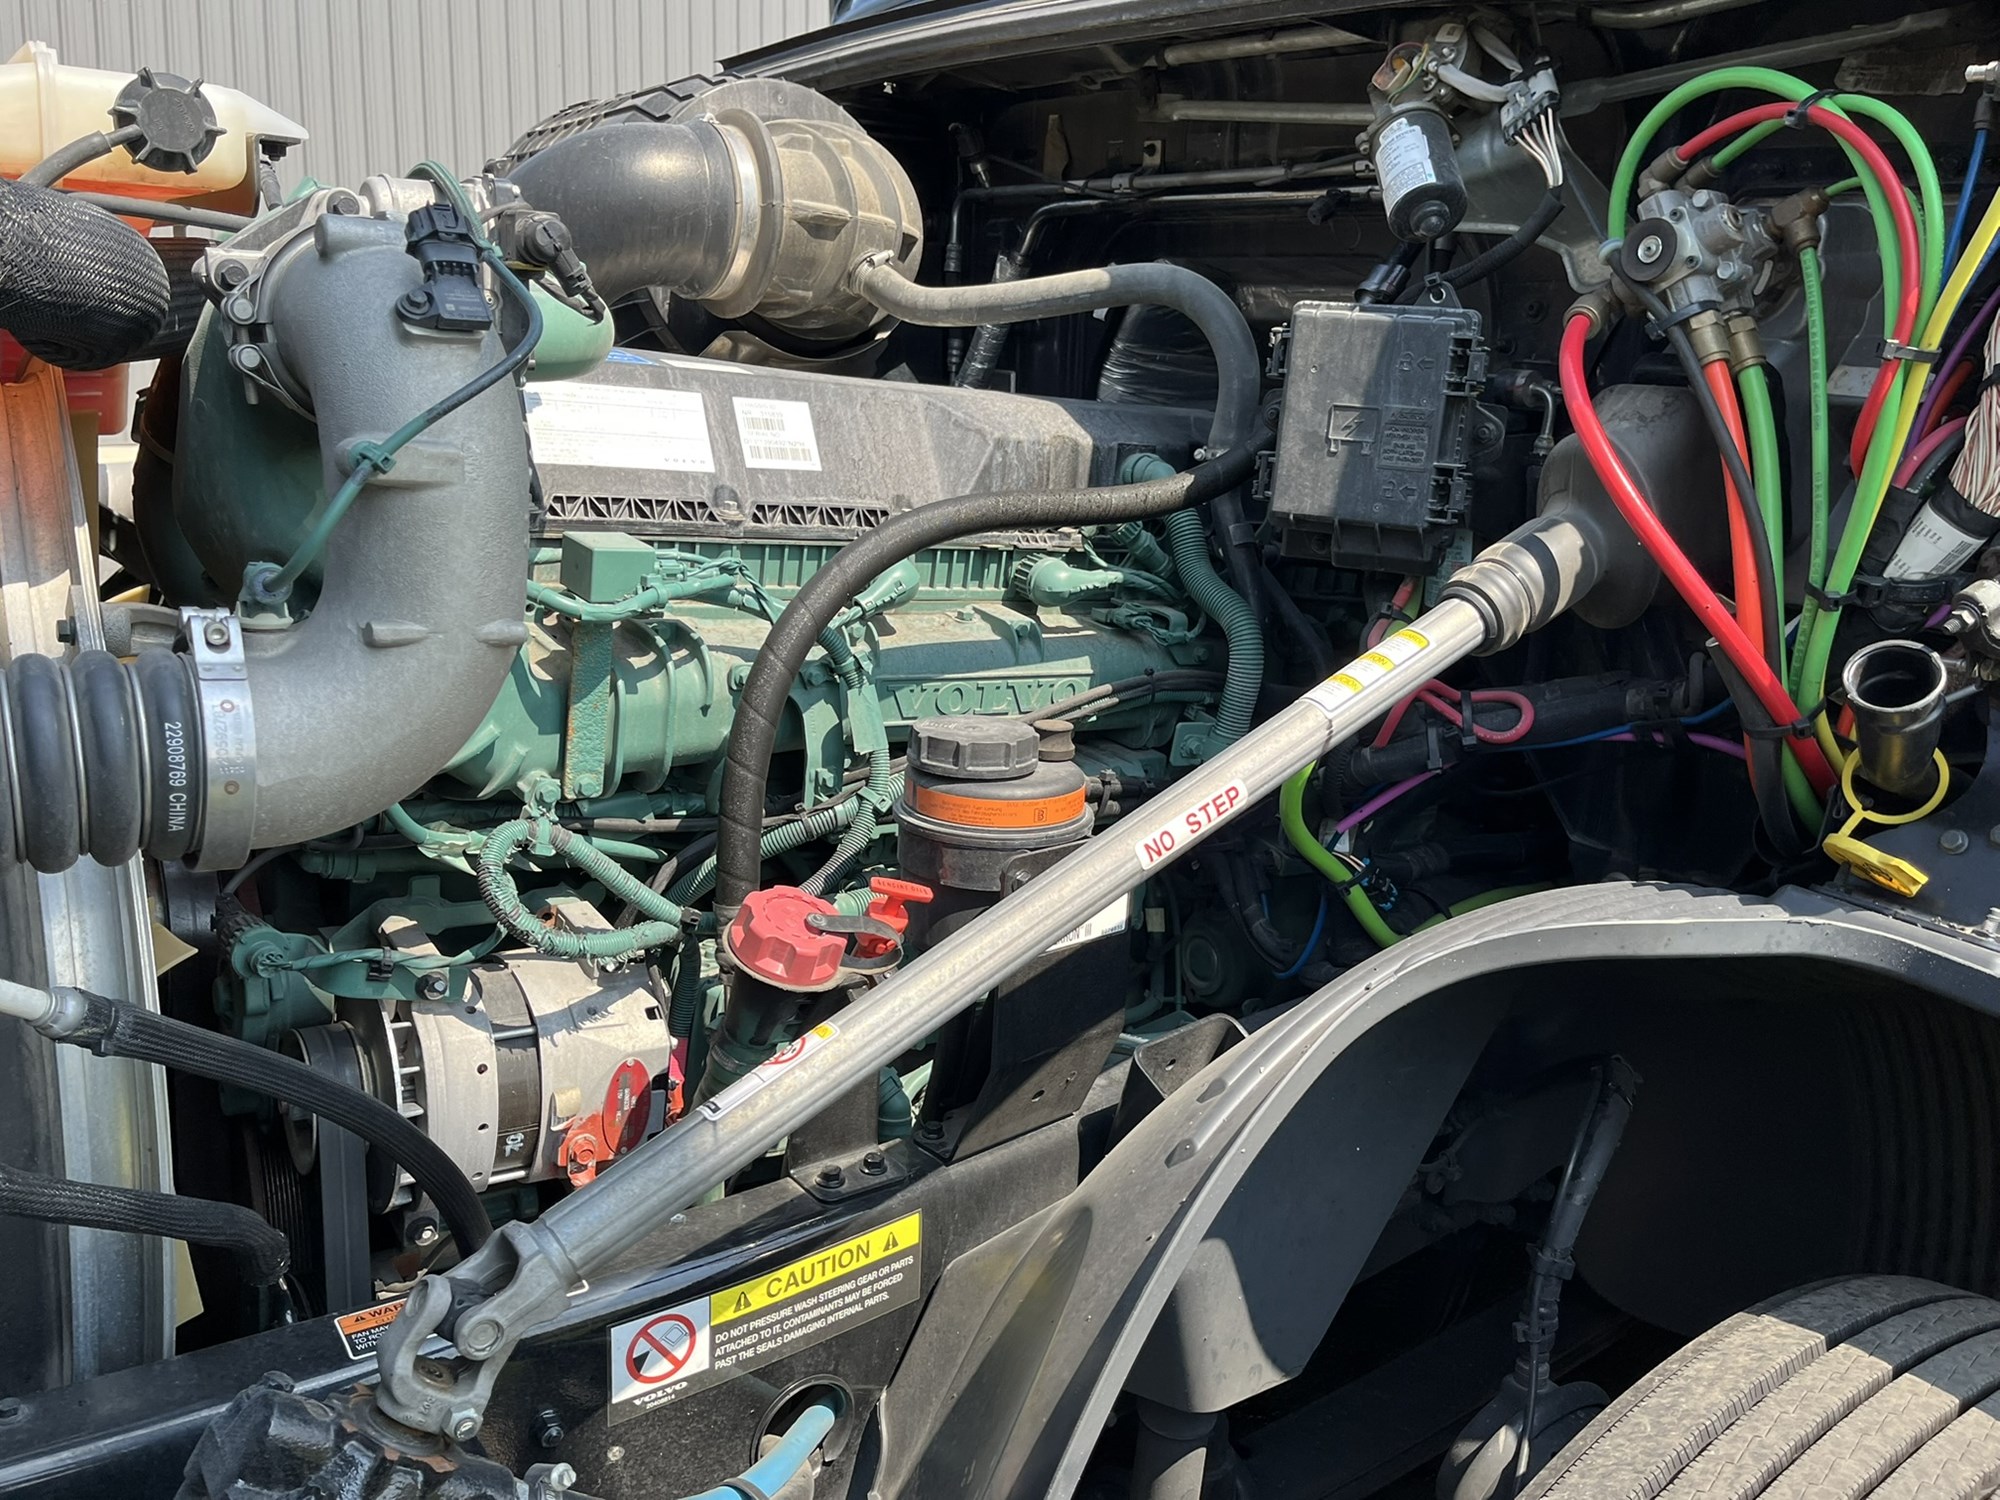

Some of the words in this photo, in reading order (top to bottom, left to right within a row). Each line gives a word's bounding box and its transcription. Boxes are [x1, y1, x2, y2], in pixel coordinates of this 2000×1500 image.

[886, 678, 1088, 720] VOLVO
[164, 721, 188, 788] 22908769
[168, 793, 188, 832] CHINA
[1143, 830, 1176, 863] NO
[1186, 786, 1240, 835] STEP
[765, 1240, 870, 1299] CAUTION
[714, 1333, 758, 1358] ATTACHED
[760, 1327, 772, 1339] TO
[773, 1324, 782, 1335] IT.
[783, 1298, 844, 1330] CONTAMINANTS
[844, 1290, 862, 1305] MAY
[862, 1285, 873, 1298] BE
[873, 1272, 904, 1292] FORCED
[715, 1331, 729, 1344] DO
[730, 1323, 748, 1338] NOT
[750, 1305, 793, 1331] PRESSURE
[794, 1295, 818, 1313] WASH
[819, 1280, 856, 1303] STEERING
[857, 1270, 878, 1286] GEAR
[878, 1265, 890, 1278] OR
[890, 1255, 914, 1272] PARTS
[351, 1331, 370, 1340] FAN
[370, 1324, 390, 1334] MAY
[353, 1337, 367, 1345] TO
[368, 1331, 386, 1341] RO
[714, 1354, 737, 1371] PAST
[738, 1347, 755, 1361] THE
[756, 1336, 783, 1354] SEALS
[783, 1318, 826, 1343] DAMAGING
[827, 1302, 864, 1325] INTERNAL
[864, 1291, 890, 1309] PARTS.
[632, 1381, 688, 1406] VOLVO
